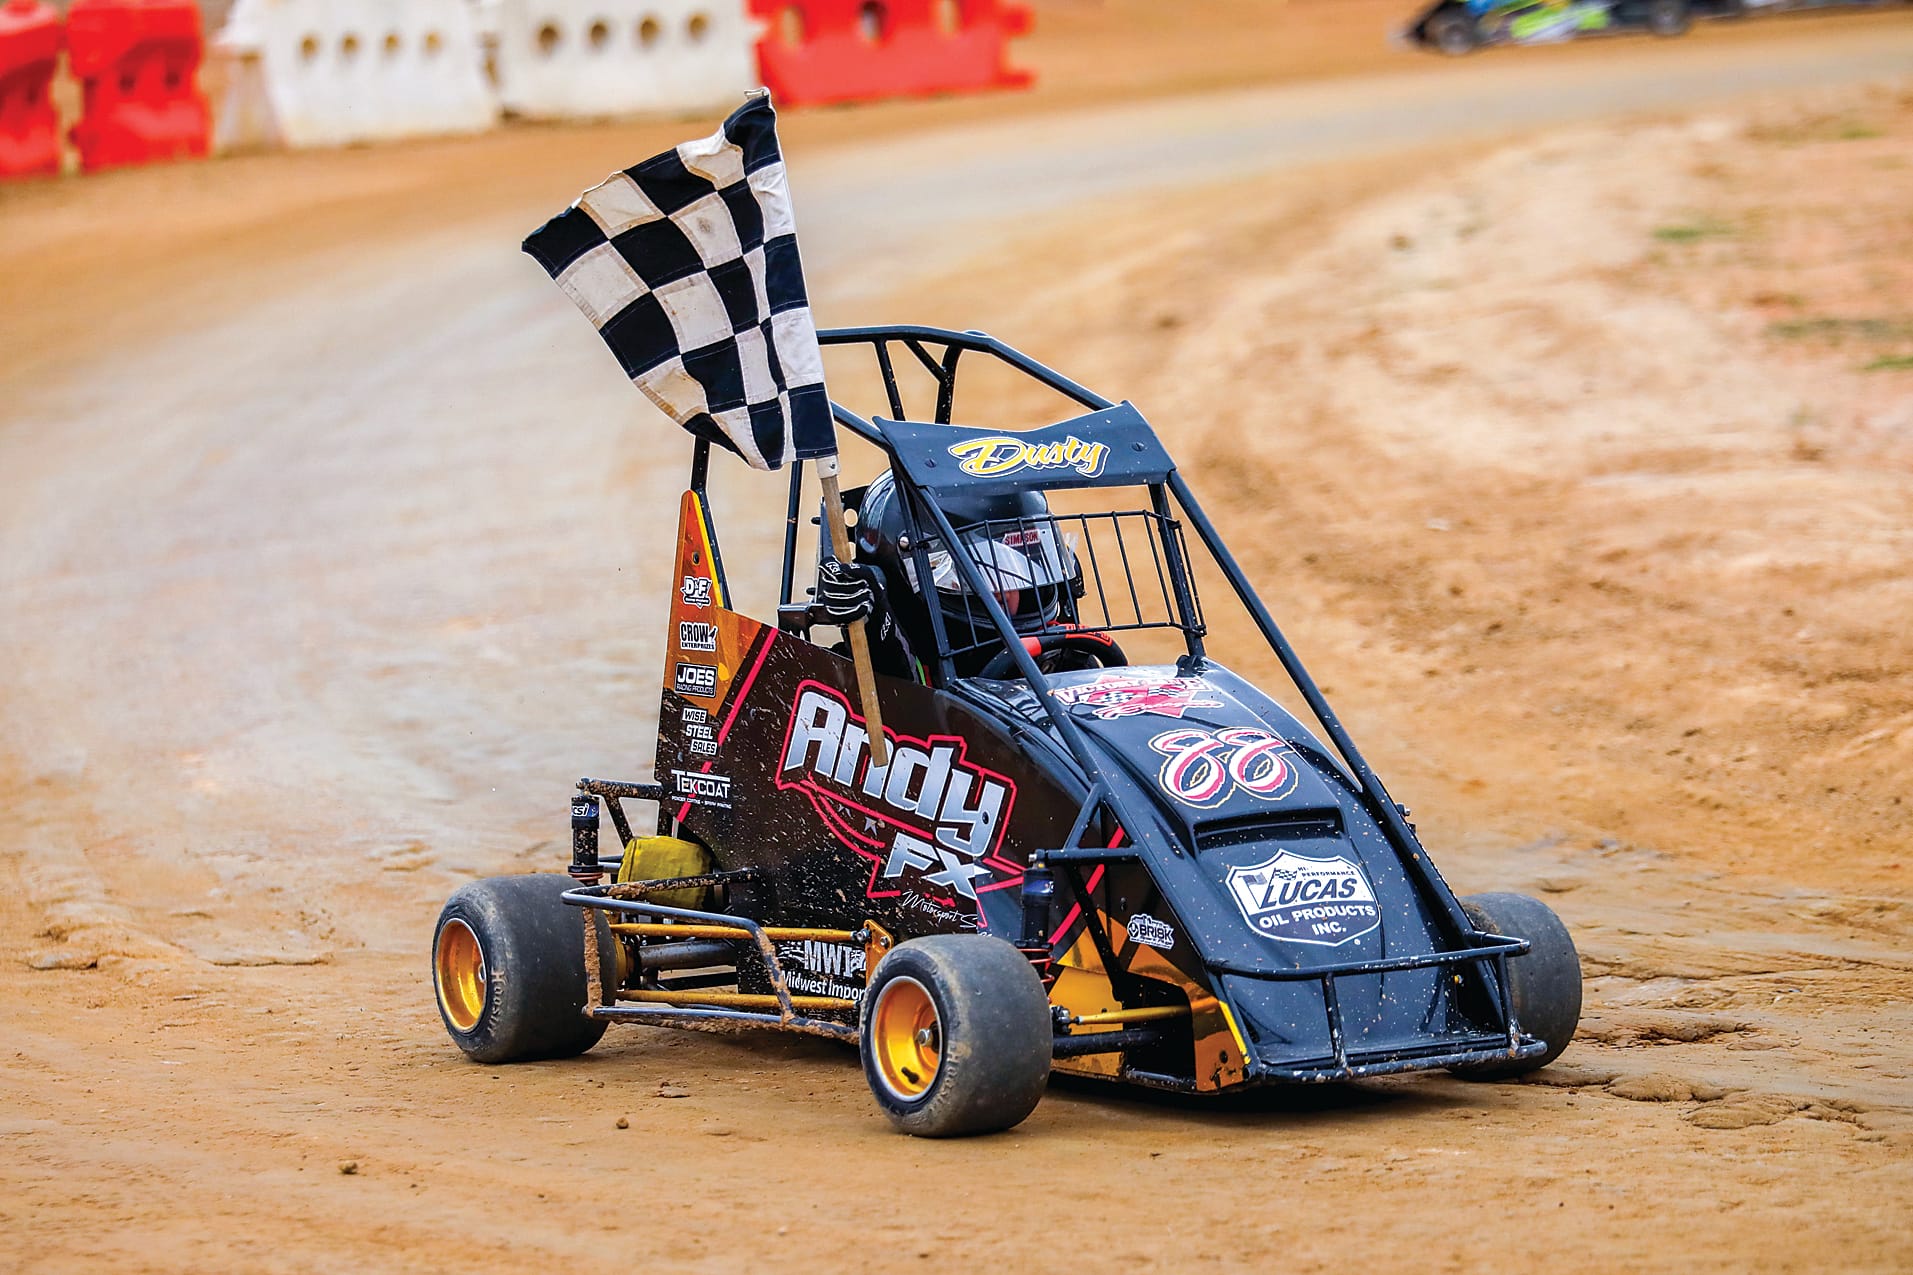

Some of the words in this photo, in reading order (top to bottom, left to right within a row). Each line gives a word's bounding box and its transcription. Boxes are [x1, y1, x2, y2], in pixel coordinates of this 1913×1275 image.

[949, 436, 1109, 477] Dusty
[1004, 531, 1038, 545] SIMSON
[681, 623, 709, 642] CROW
[678, 667, 714, 686] JOES
[684, 709, 705, 722] WISE
[686, 724, 713, 740] STEEL
[692, 742, 716, 754] SALES
[784, 691, 1005, 857] Andy
[1149, 727, 1298, 809] 88
[671, 769, 731, 798] TEKCOAT
[884, 832, 992, 900] FX
[1261, 878, 1358, 907] LUCAS
[1259, 914, 1290, 929] OIL
[1291, 905, 1376, 922] PRODUCTS
[1311, 921, 1347, 936] INC.
[781, 970, 829, 995] Midwest
